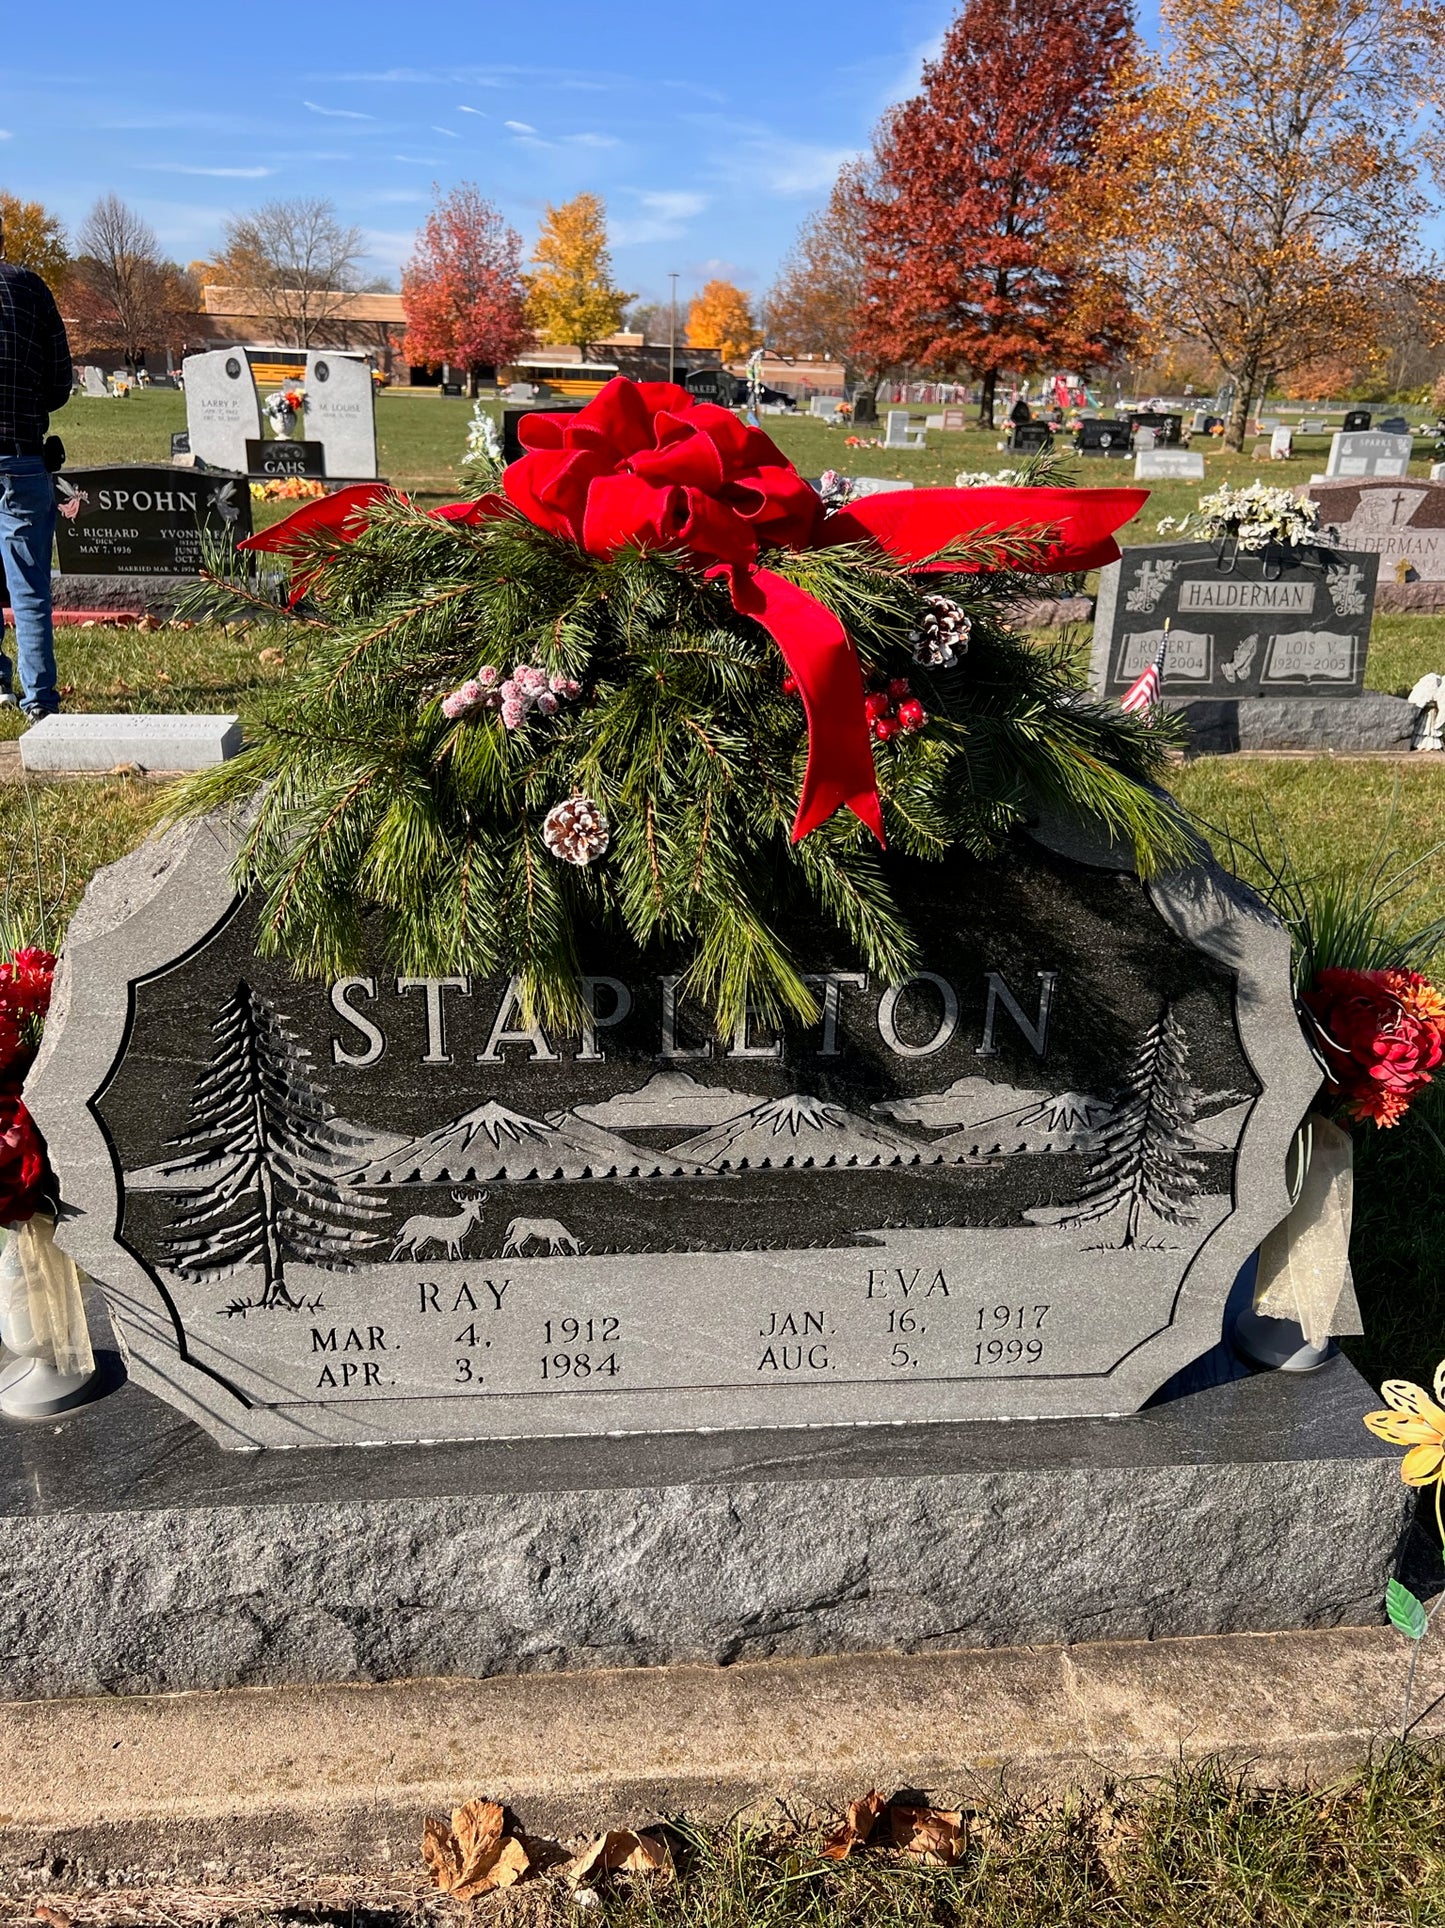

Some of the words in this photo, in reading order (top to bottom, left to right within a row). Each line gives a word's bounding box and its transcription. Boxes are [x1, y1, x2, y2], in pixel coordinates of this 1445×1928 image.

[689, 384, 717, 393] BAKER
[201, 399, 229, 408] LARRY
[332, 403, 361, 412] LOUISE
[1359, 438, 1392, 447] SPARKS
[264, 461, 306, 474] GAHS
[98, 489, 197, 512] SPOHN
[68, 528, 79, 538] C.
[83, 528, 139, 538] RICHARD
[80, 545, 100, 554] MAY
[113, 546, 132, 554] 1936
[174, 546, 199, 556] JUNE
[174, 555, 196, 564] OCT.
[118, 565, 151, 573] MARRIED
[1189, 584, 1306, 608] HALDERMAN
[1139, 640, 1193, 653] ROERT
[1285, 641, 1316, 655] LOIS
[1327, 641, 1338, 655] V.
[1169, 657, 1203, 669] 2004
[329, 968, 1058, 1067] STAPLETON
[867, 1267, 953, 1299] EVA
[419, 1280, 514, 1313] RAY
[759, 1311, 837, 1338] JAN.
[886, 1308, 927, 1337] 16,
[975, 1304, 1051, 1332] 1917
[311, 1325, 402, 1353] MAR.
[455, 1322, 493, 1350] 4,
[542, 1315, 621, 1344] 1912
[757, 1344, 837, 1371] AUG.
[890, 1341, 919, 1369] 5,
[973, 1337, 1045, 1365] 1999
[316, 1361, 397, 1388] APR.
[454, 1359, 486, 1384] 3,
[540, 1351, 621, 1380] 1984
